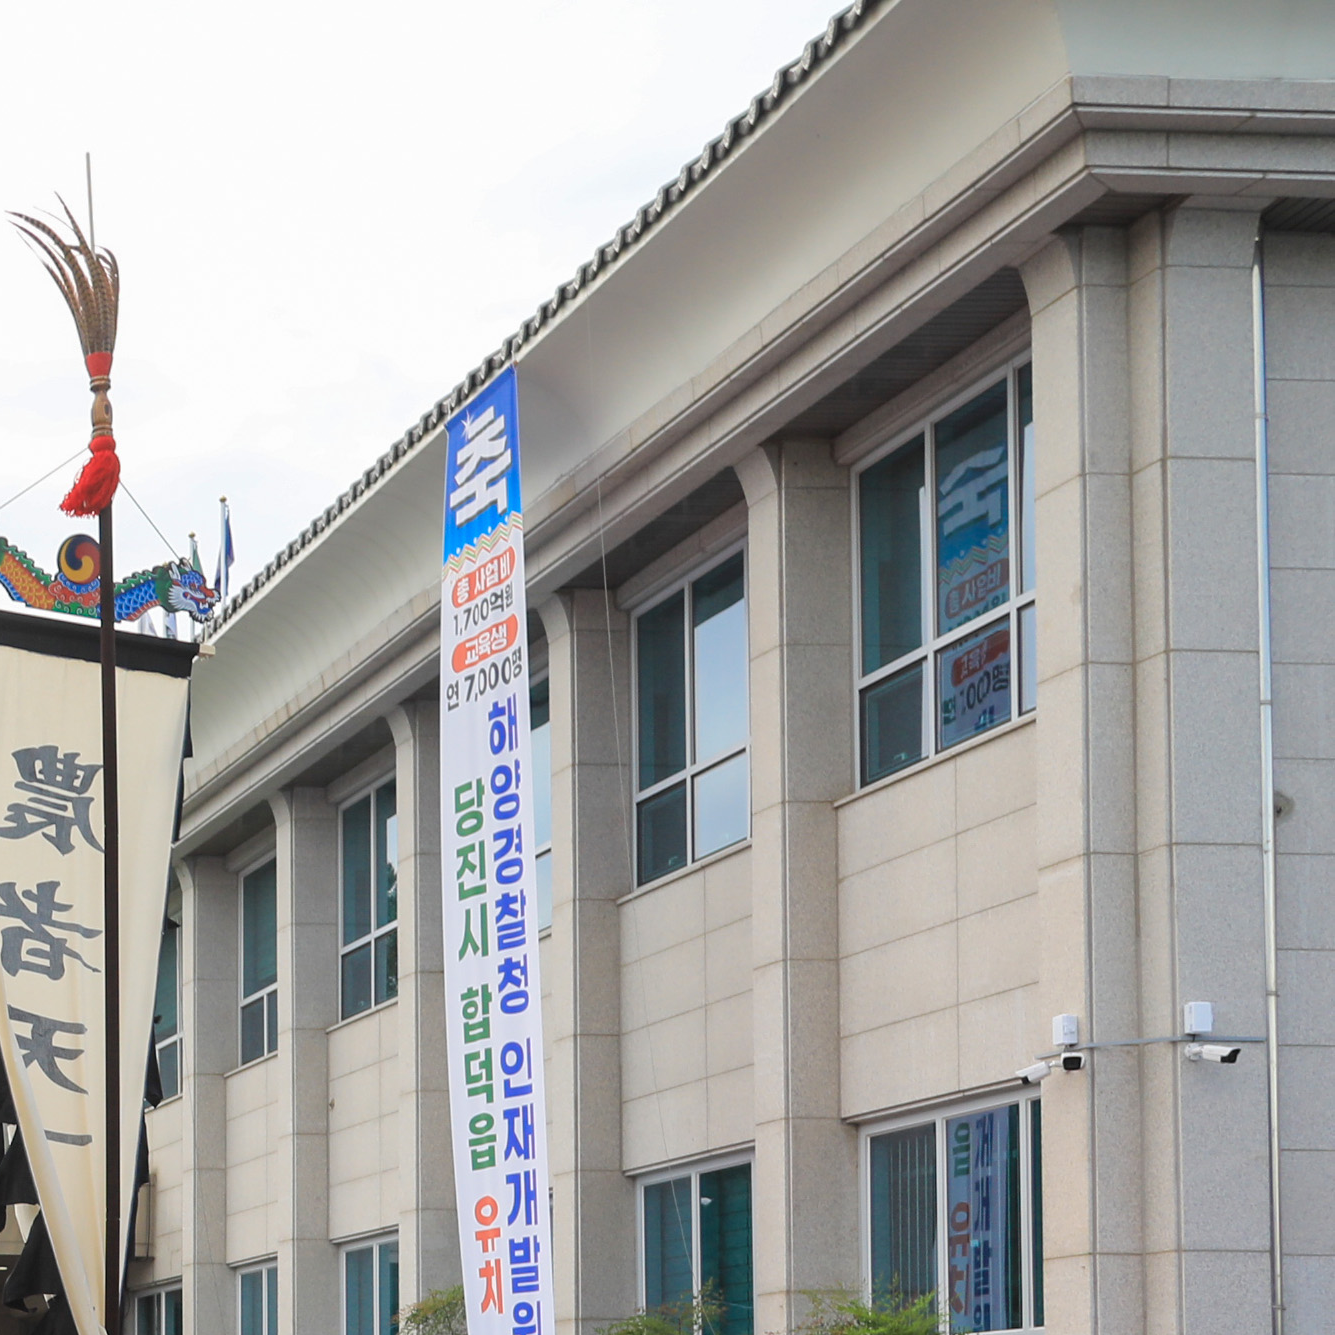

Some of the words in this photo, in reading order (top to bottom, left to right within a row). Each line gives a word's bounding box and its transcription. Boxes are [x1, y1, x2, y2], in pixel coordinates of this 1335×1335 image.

[449, 405, 513, 528] 축
[453, 581, 513, 636] 1,700억원
[457, 578, 470, 604] 총
[474, 551, 511, 594] 사업비
[446, 679, 459, 712] 연
[464, 646, 523, 702] 7,000명
[465, 623, 508, 666] 교육생
[455, 778, 490, 962] 당진시
[488, 692, 529, 1016] 해양경찰청
[461, 983, 498, 1172] 합덕읍
[473, 1196, 504, 1316] 유치
